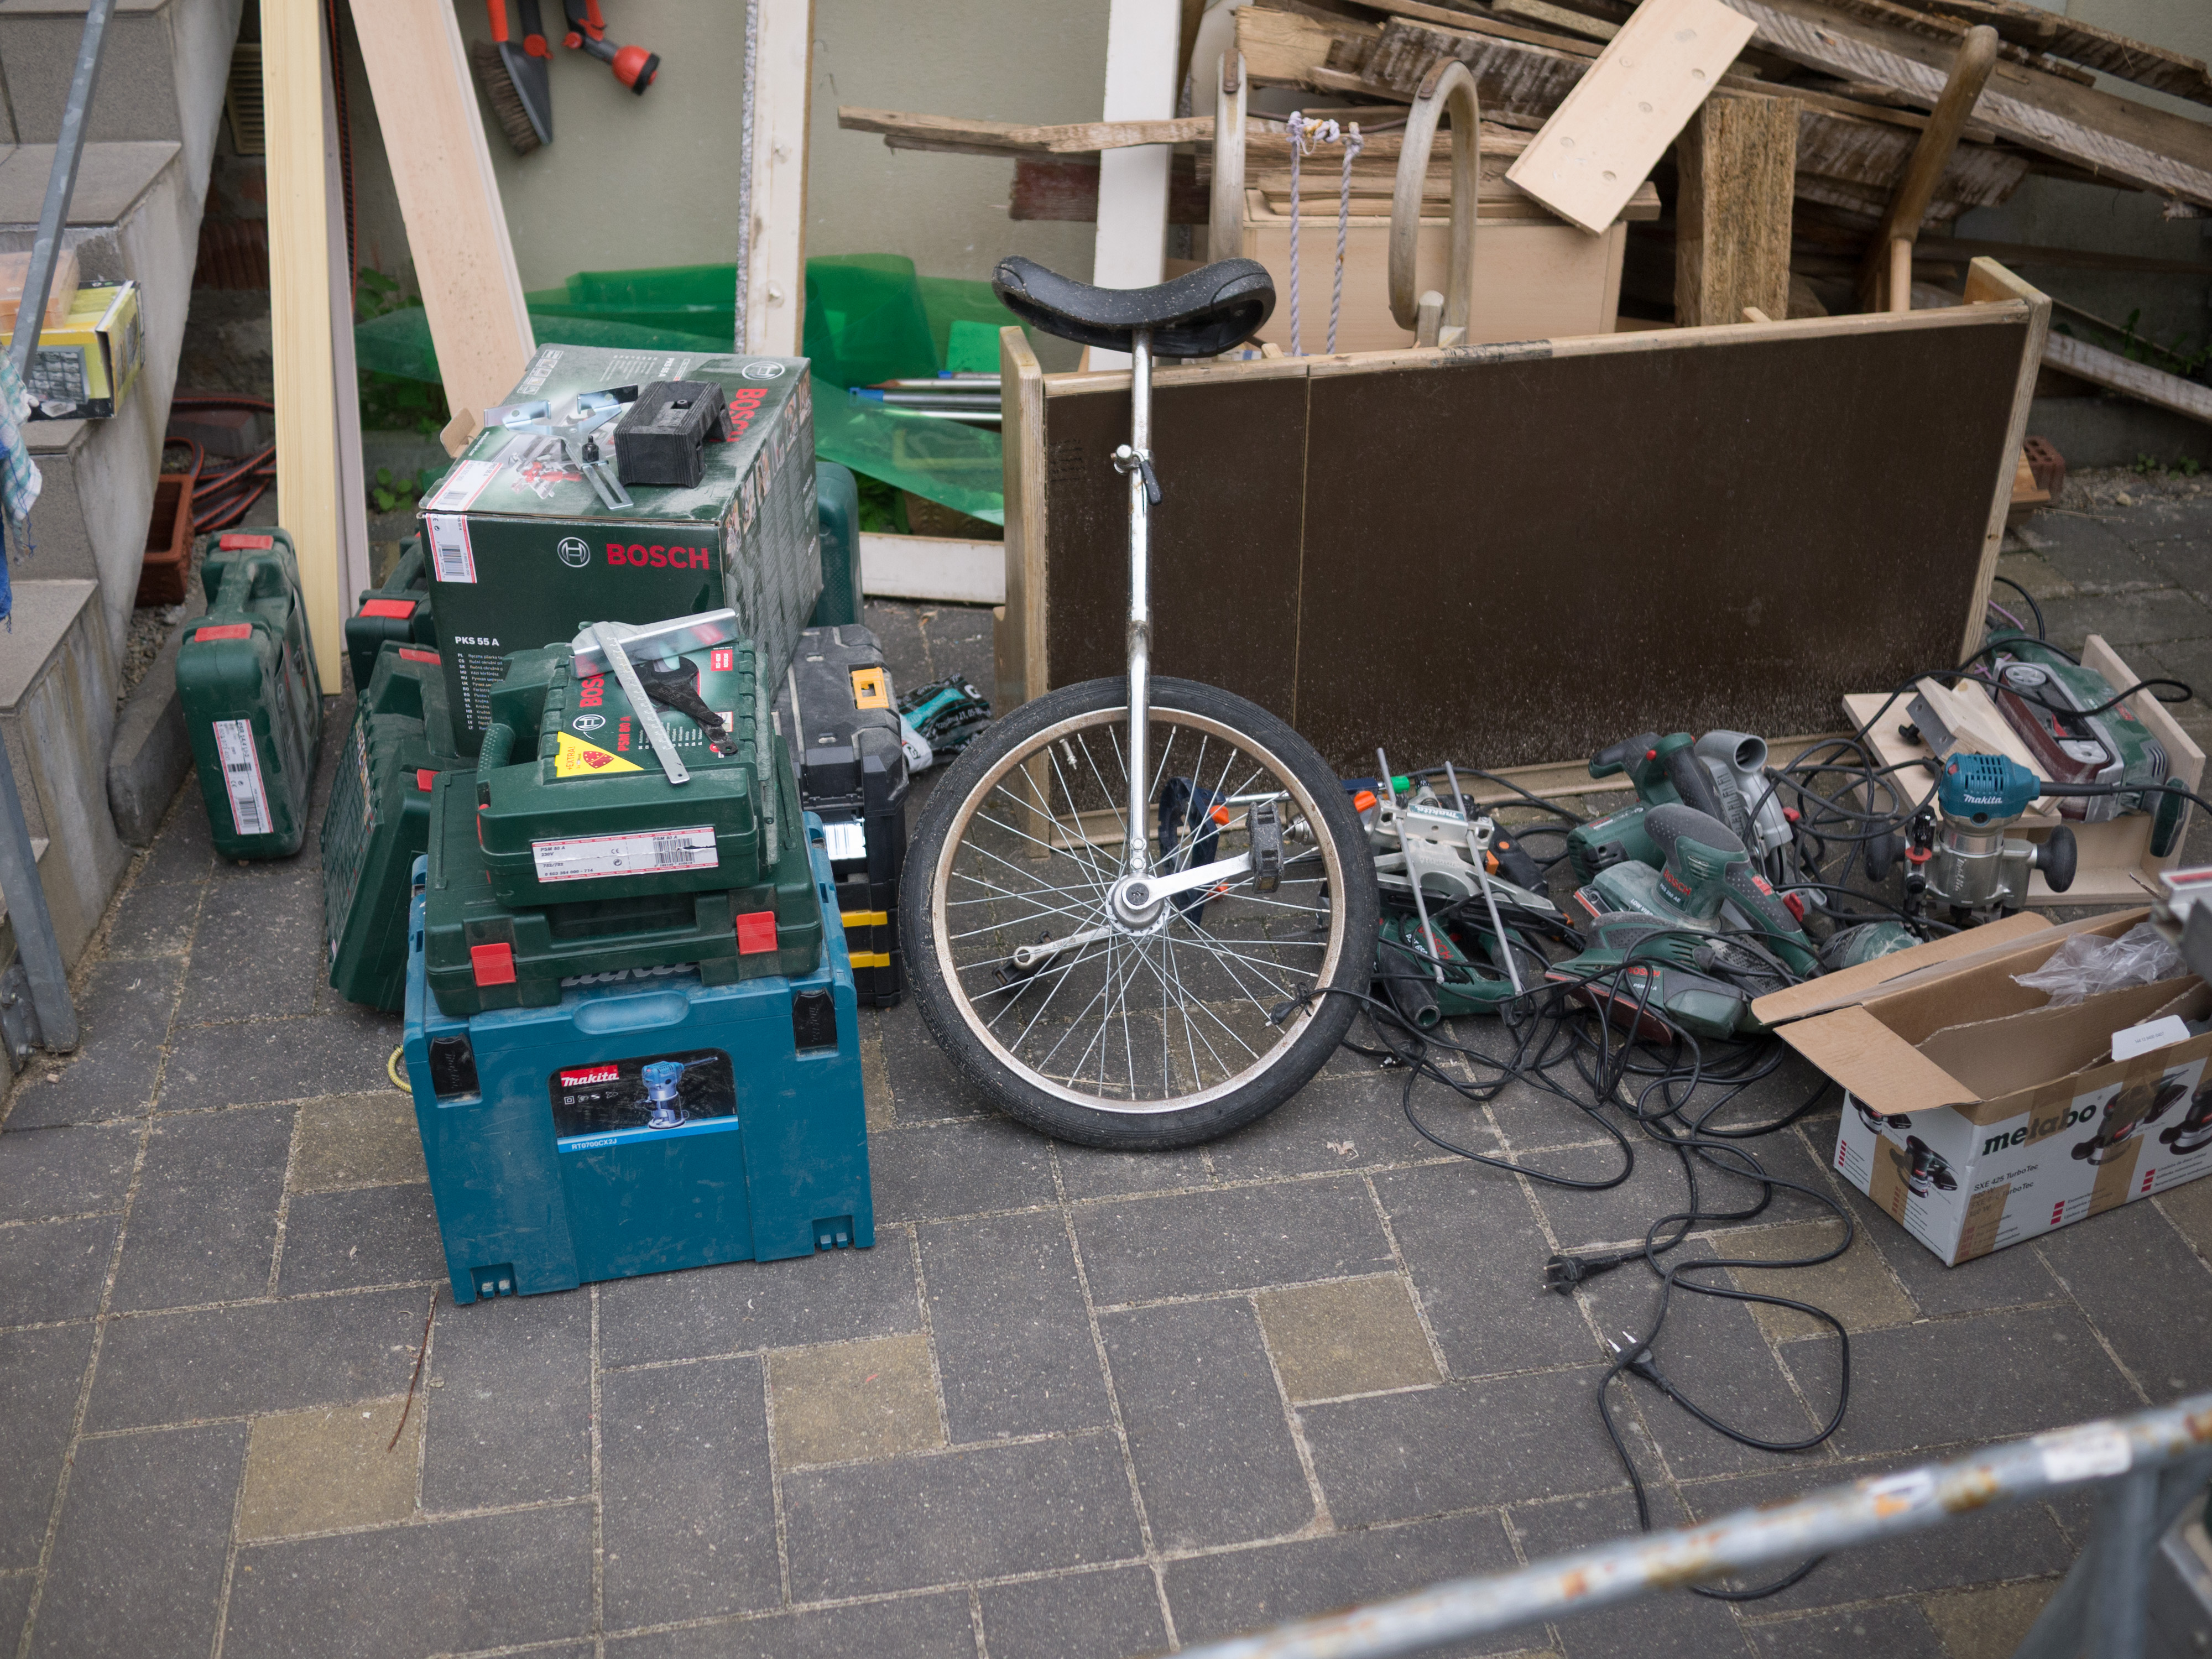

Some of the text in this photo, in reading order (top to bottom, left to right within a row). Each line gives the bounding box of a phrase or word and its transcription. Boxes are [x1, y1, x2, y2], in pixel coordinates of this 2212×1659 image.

[606, 543, 709, 570] BOSCH
[455, 637, 475, 645] PKS
[579, 674, 604, 707] BOS
[618, 734, 630, 752] PSM
[567, 746, 576, 771] +EXTRA!
[1963, 794, 2003, 805] makita
[1415, 805, 1459, 819] makita
[1663, 868, 1692, 896] BOSCH
[1631, 898, 1642, 909] LOW
[1627, 967, 1661, 978] BOSH
[561, 1072, 619, 1087] makita
[1981, 1104, 2097, 1156] metabo
[572, 1139, 617, 1150] RT0700CX2J
[1974, 1181, 1990, 1191] SXE
[1991, 1176, 2004, 1185] 425
